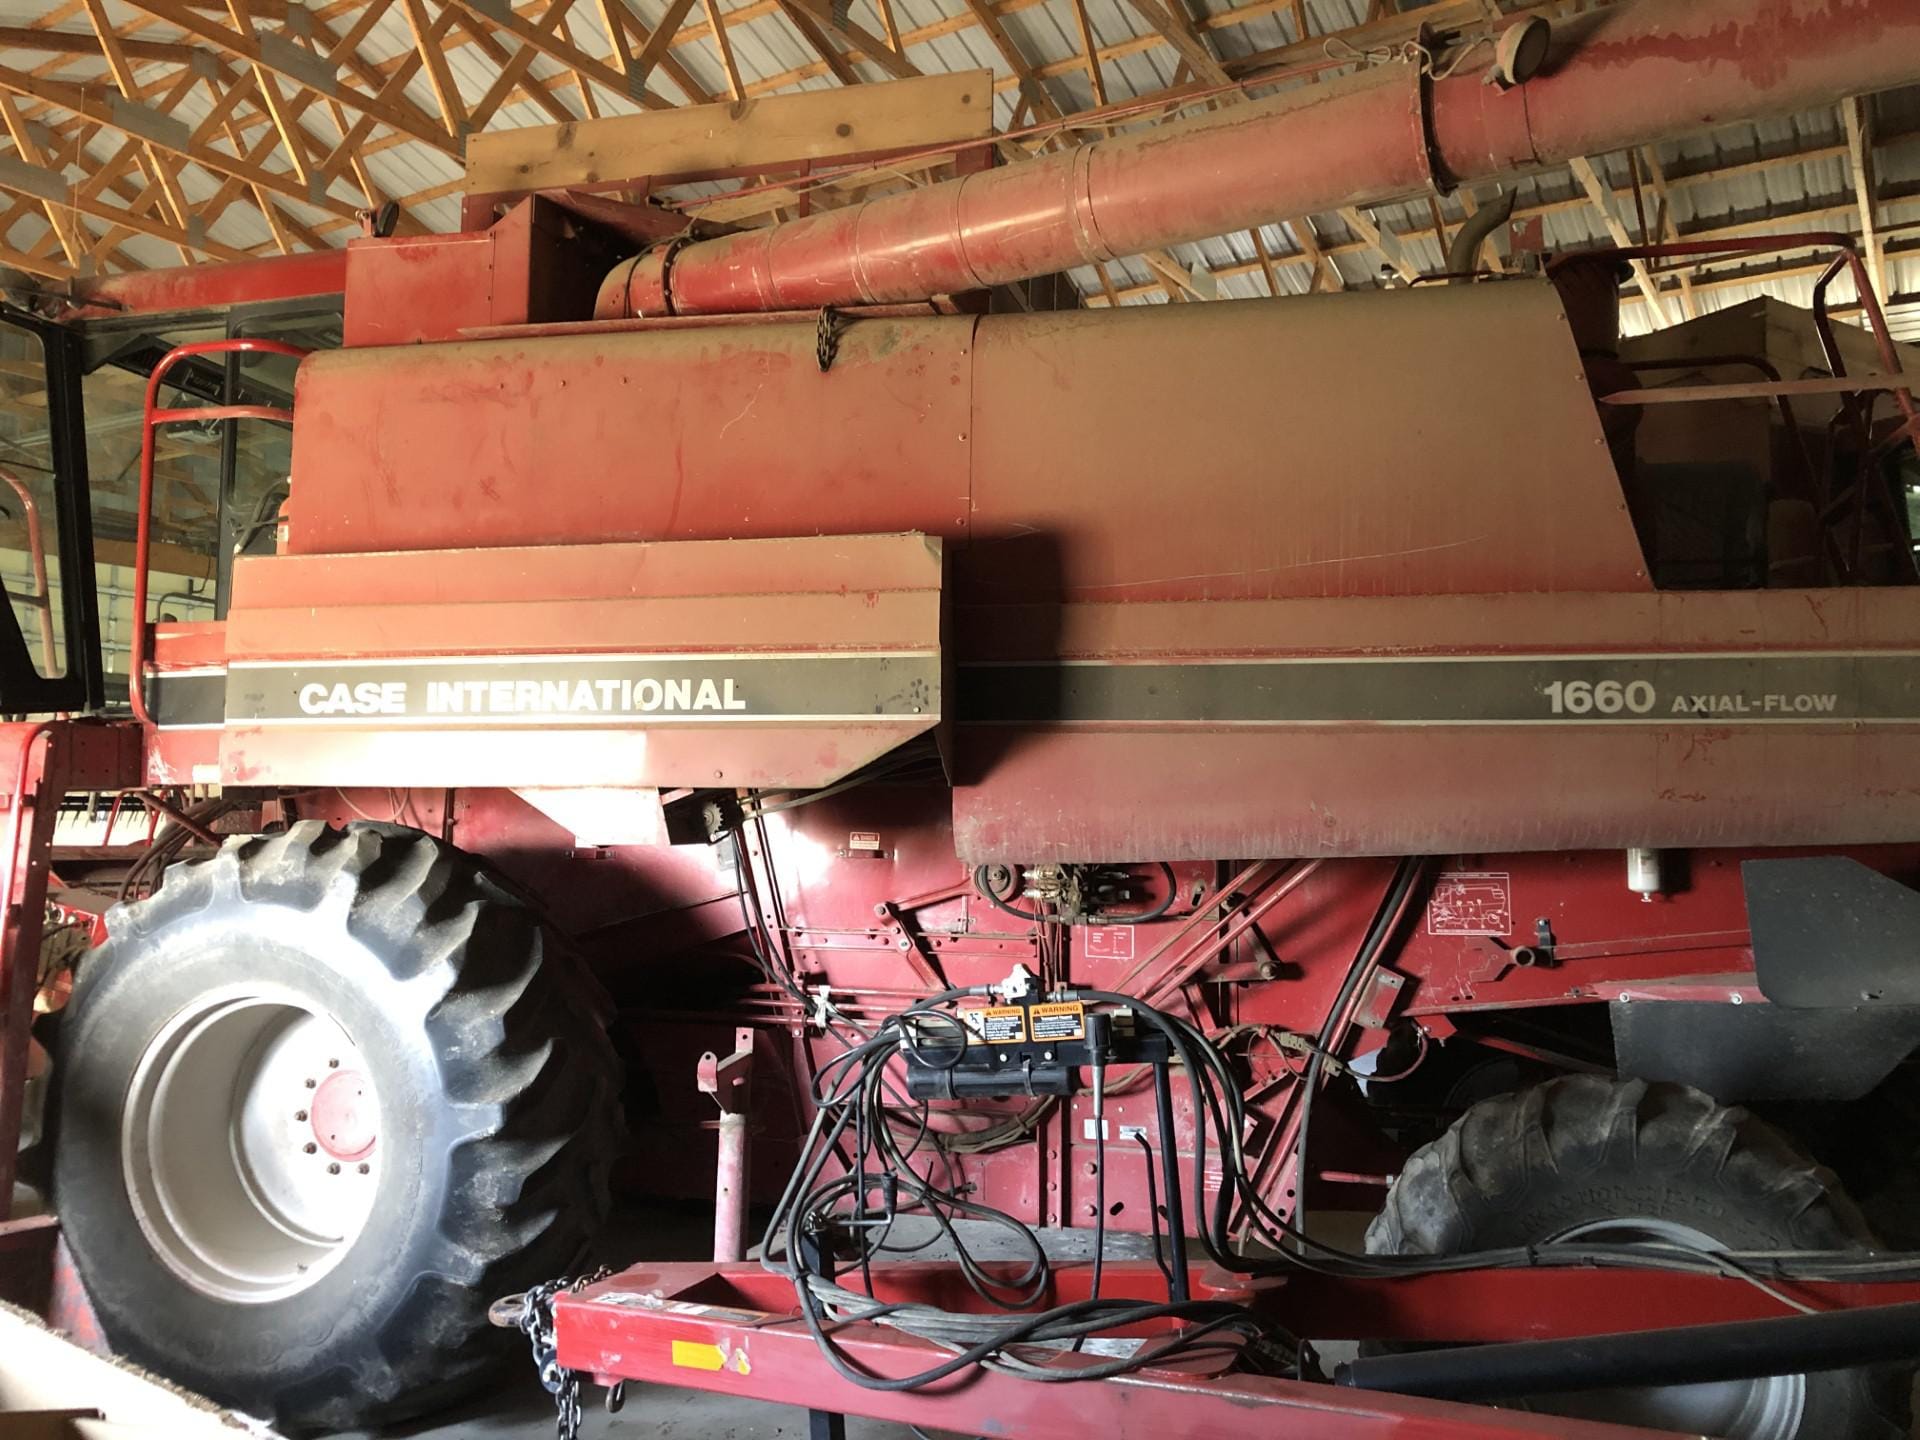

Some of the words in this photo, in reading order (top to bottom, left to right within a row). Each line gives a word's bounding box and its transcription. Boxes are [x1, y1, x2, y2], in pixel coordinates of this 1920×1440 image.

[300, 682, 406, 714] CASE
[426, 678, 746, 713] INTERNATIONAL
[1544, 680, 1656, 713] 1660
[1671, 694, 1837, 712] AXIAL-FLOW
[992, 1008, 1021, 1016] WARNING
[1041, 1004, 1080, 1013] WARNING
